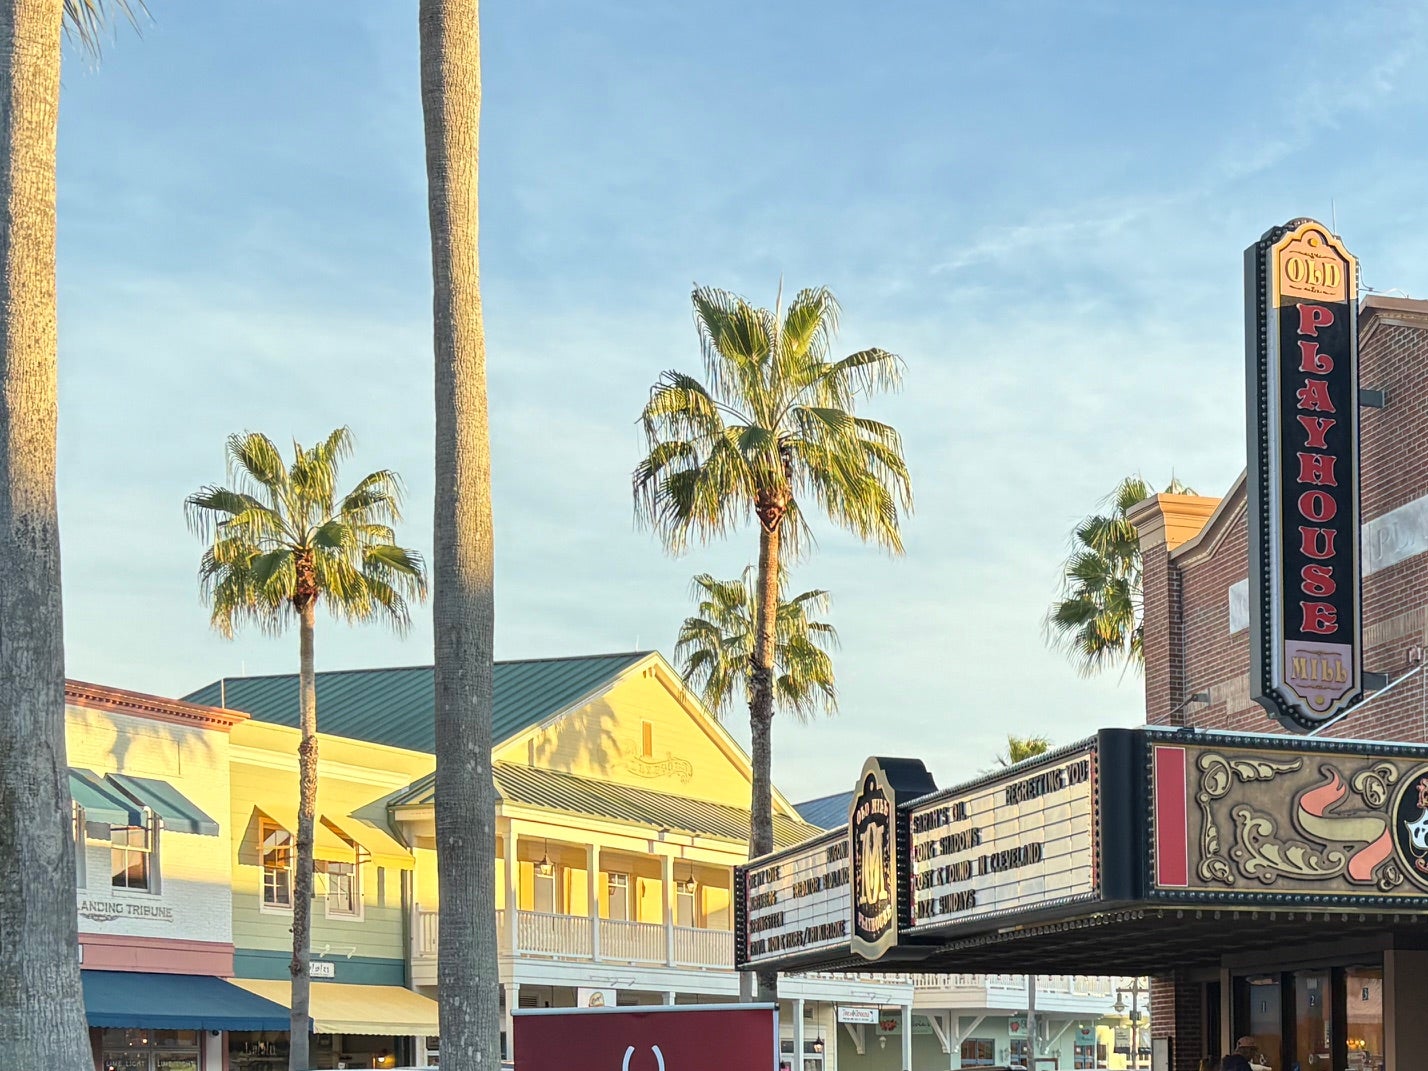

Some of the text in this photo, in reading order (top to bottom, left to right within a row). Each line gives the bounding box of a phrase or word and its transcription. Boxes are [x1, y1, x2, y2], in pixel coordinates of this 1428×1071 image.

[1285, 257, 1341, 288] OLD
[1296, 303, 1339, 634] PLAYHOUSE
[1291, 656, 1347, 684] MILL
[1006, 769, 1061, 806] REGRETTING
[914, 802, 968, 834] SARAH'S OIL
[940, 827, 981, 855] SHADOWS
[991, 842, 1042, 872] CLEVELAND
[77, 900, 173, 918] ANDING TRIBUNE
[939, 889, 976, 914] SUNDAYS
